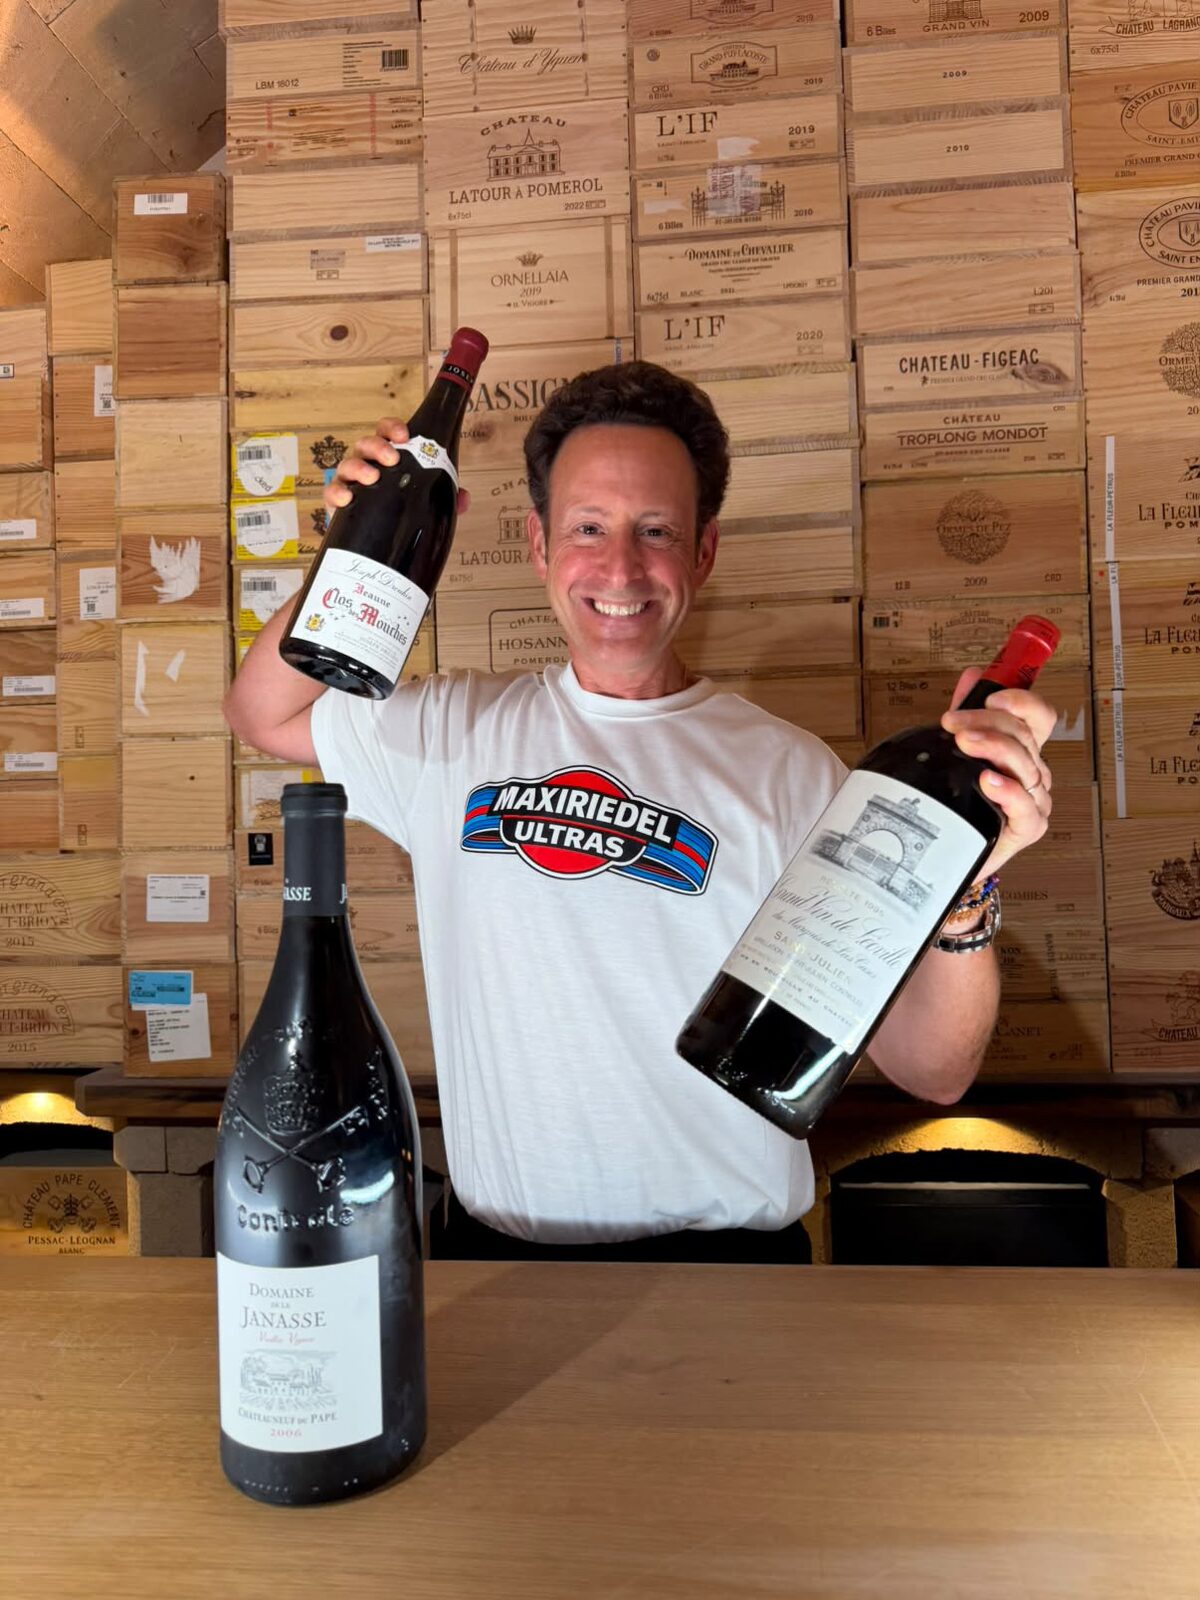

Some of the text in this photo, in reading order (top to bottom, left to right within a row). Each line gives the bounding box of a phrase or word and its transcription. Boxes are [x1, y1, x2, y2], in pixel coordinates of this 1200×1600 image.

[1018, 10, 1050, 24] 2009
[866, 26, 873, 36] 6
[923, 19, 990, 33] GRAND VIN
[1116, 20, 1155, 35] CHATEAU
[1090, 44, 1120, 55] 6x75cl
[804, 77, 824, 85] 2019
[942, 70, 967, 78] 2009
[255, 78, 299, 90] LBM 18012
[1124, 85, 1166, 119] CHATEAU
[1168, 81, 1198, 93] PAVIE
[480, 115, 567, 136] CHATEAU
[656, 111, 718, 137] L'IF
[788, 125, 815, 135] 2019
[1145, 134, 1176, 145] SAINT
[946, 144, 970, 153] 2010
[1125, 156, 1162, 167] PREMIER
[1163, 152, 1195, 163] GRAND
[449, 186, 511, 204] LATOUR
[527, 178, 603, 198] POMEROL
[564, 201, 584, 211] 2022
[793, 208, 814, 217] 2010
[1144, 208, 1173, 248] CHATEAU
[684, 247, 731, 262] DOMAINE
[741, 243, 795, 256] CHEVALIER
[1158, 250, 1188, 264] SAINT
[490, 269, 569, 288] ORNELLAIA
[1136, 276, 1172, 286] PREMIER
[519, 287, 542, 298] 2019
[1181, 287, 1199, 297] 201
[663, 314, 725, 341] L'IF
[796, 330, 824, 341] 2020
[1159, 355, 1196, 367] ORMES
[464, 377, 571, 413] ASSIC
[1187, 405, 1200, 415] 20
[943, 413, 1001, 425] CHÂTEAU
[897, 426, 1049, 447] TROPLONG MONDOT
[1138, 502, 1200, 521] LA FLEU
[1164, 520, 1199, 529] POM
[459, 550, 523, 566] LATOUR
[347, 558, 379, 581] Joseph
[964, 576, 987, 588] 2009
[321, 586, 354, 609] Clos
[356, 602, 408, 646] Mouches
[509, 615, 560, 630] CHATEA
[1145, 626, 1161, 645] LA
[499, 637, 569, 651] HOSANN
[513, 655, 567, 666] POMEROL
[1150, 756, 1167, 775] LA
[492, 785, 672, 845] MAXIRIEDEL
[513, 820, 625, 859] ULTRAS
[7, 1042, 37, 1053] 2015
[55, 1173, 84, 1186] PAPE
[59, 1247, 85, 1255] BLANC
[249, 1282, 315, 1299] DOMAINE
[241, 1306, 327, 1330] JANASSE
[310, 1411, 338, 1424] PAPE
[270, 1427, 302, 1438] 2006
